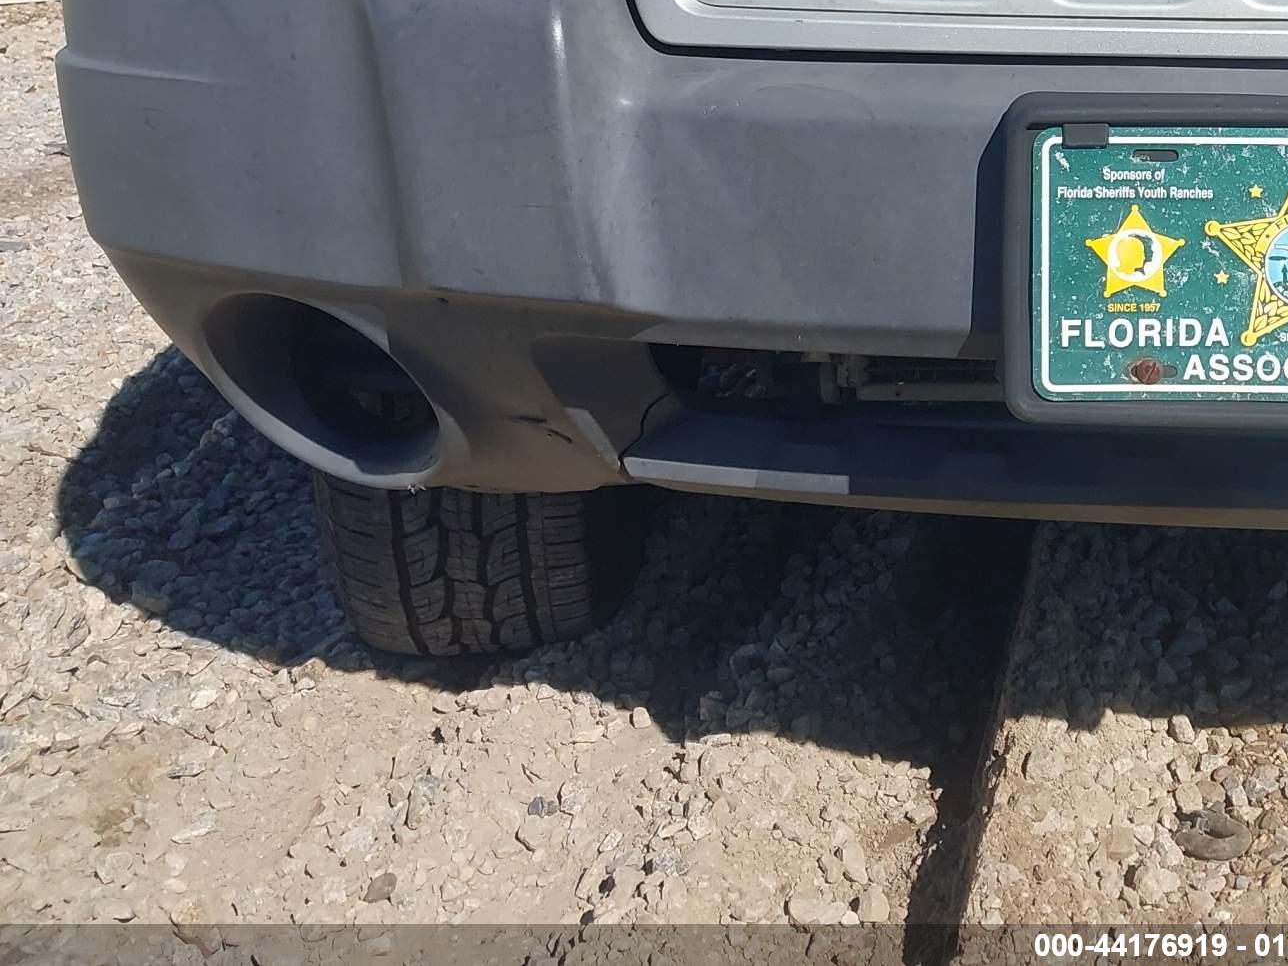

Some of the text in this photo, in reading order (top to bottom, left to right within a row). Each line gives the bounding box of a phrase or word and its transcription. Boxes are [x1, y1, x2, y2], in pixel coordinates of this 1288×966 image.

[1103, 168, 1165, 181] Sponsors of
[1057, 186, 1213, 199] Florida Sheriffs Youth Ranches
[1107, 303, 1161, 312] SINCE 1957
[1061, 318, 1230, 349] FLORIDA
